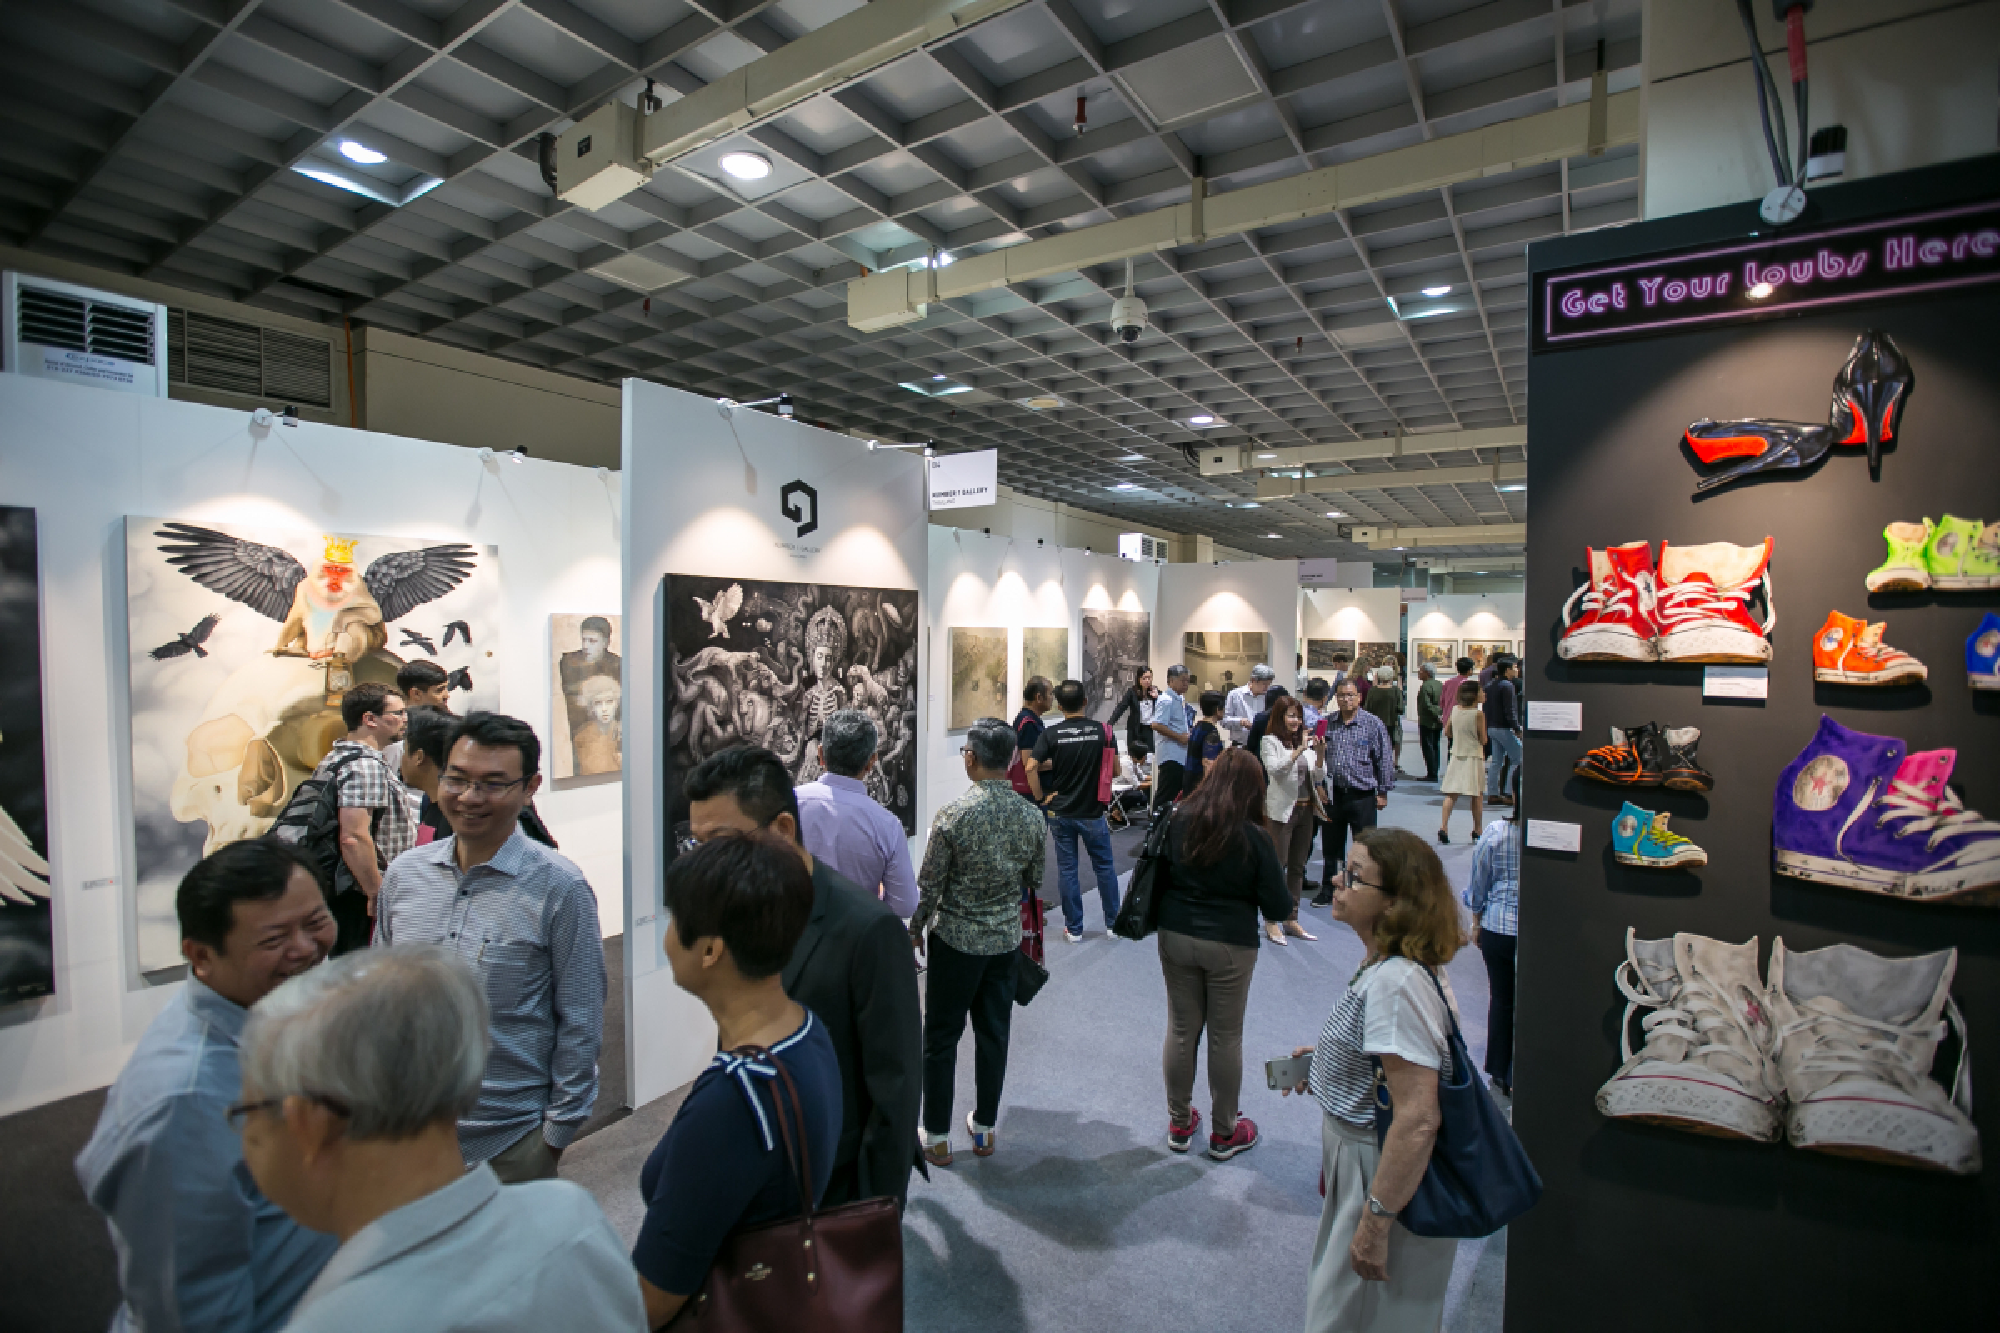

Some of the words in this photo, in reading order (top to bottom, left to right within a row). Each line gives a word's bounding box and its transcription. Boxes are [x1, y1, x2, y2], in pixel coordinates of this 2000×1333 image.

[1560, 282, 1627, 318] Get
[1637, 271, 1732, 306] Your
[1744, 250, 1869, 298] Loubs
[1884, 230, 2000, 270] Here
